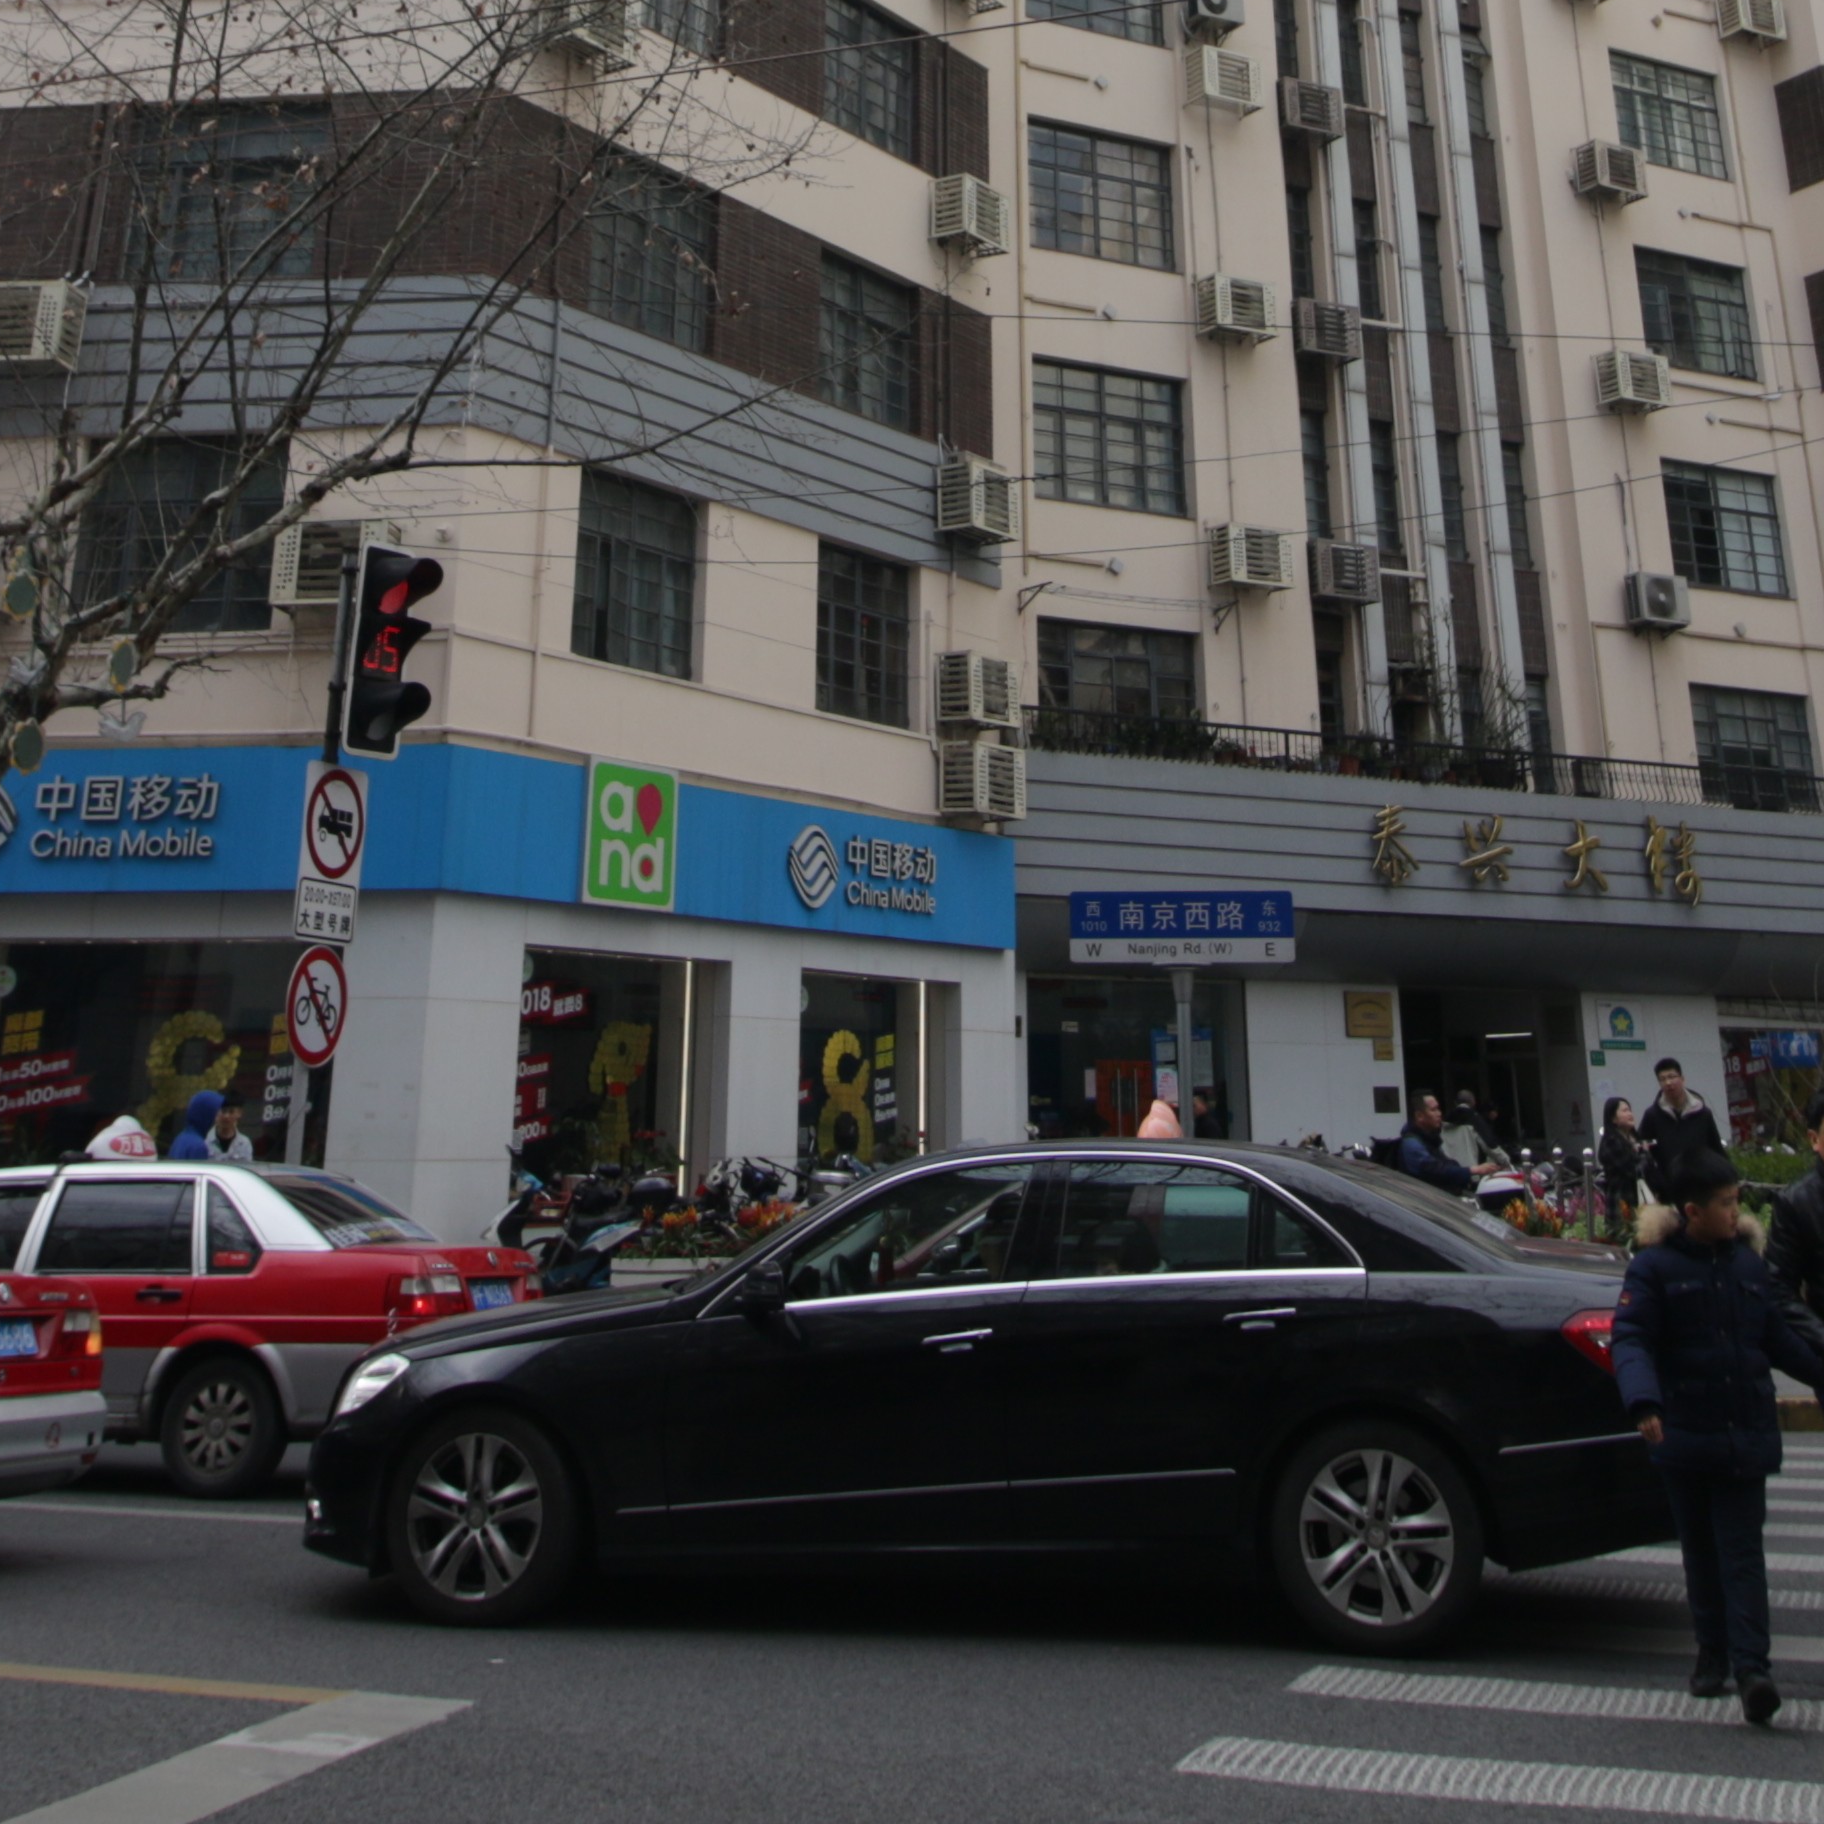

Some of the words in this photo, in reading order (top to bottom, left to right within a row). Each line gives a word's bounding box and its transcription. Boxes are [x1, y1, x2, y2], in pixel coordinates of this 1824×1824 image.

[33, 773, 222, 823] 中国移动
[29, 828, 112, 861] China
[117, 827, 215, 860] Mobile
[1372, 803, 1704, 908] 泰兴大楼
[846, 833, 939, 886] 中国移动
[846, 881, 890, 909] China
[891, 887, 938, 915] Mobile
[1085, 900, 1102, 918] 西
[1261, 899, 1277, 917] 东
[1081, 920, 1107, 932] 1010
[1118, 900, 1245, 931] 南京西路
[1257, 920, 1281, 932] 932
[1086, 943, 1102, 957] W
[1128, 942, 1176, 956] Nanjing
[1265, 942, 1276, 957] E
[521, 986, 551, 1015] 018
